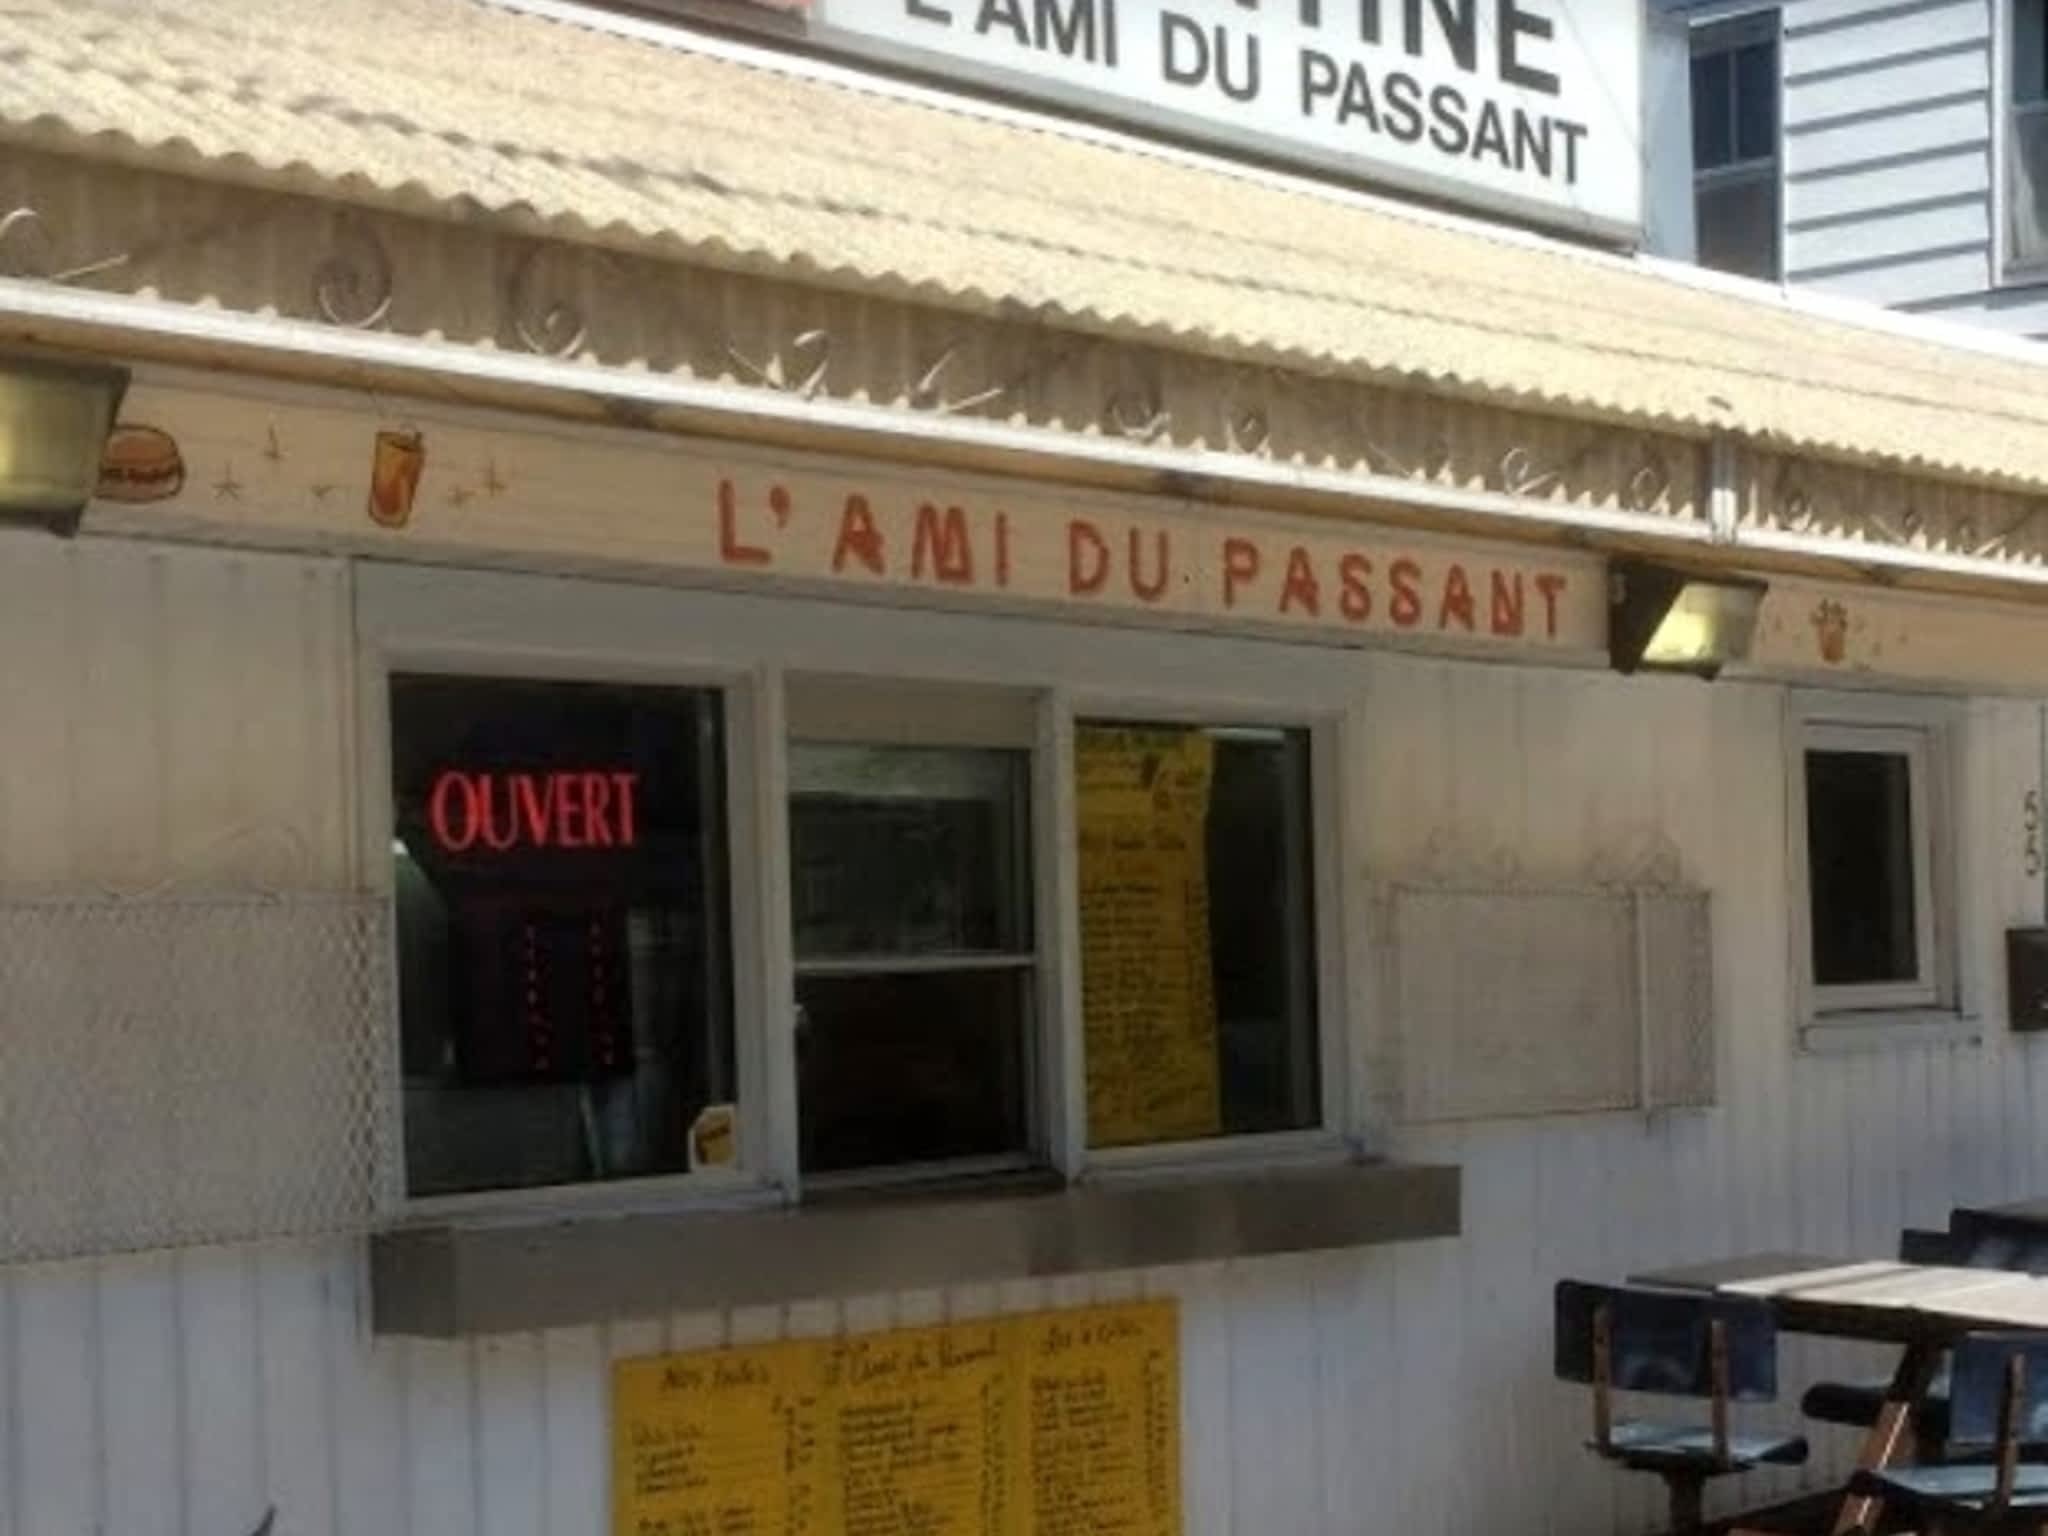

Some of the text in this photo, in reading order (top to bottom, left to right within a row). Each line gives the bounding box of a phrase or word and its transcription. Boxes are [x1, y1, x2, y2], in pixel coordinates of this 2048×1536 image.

[1160, 11, 1260, 101] DU
[1298, 48, 1589, 184] PASSANT
[1068, 519, 1171, 600] DU
[1222, 537, 1568, 639] PASSANT
[430, 770, 640, 850] OUVERT
